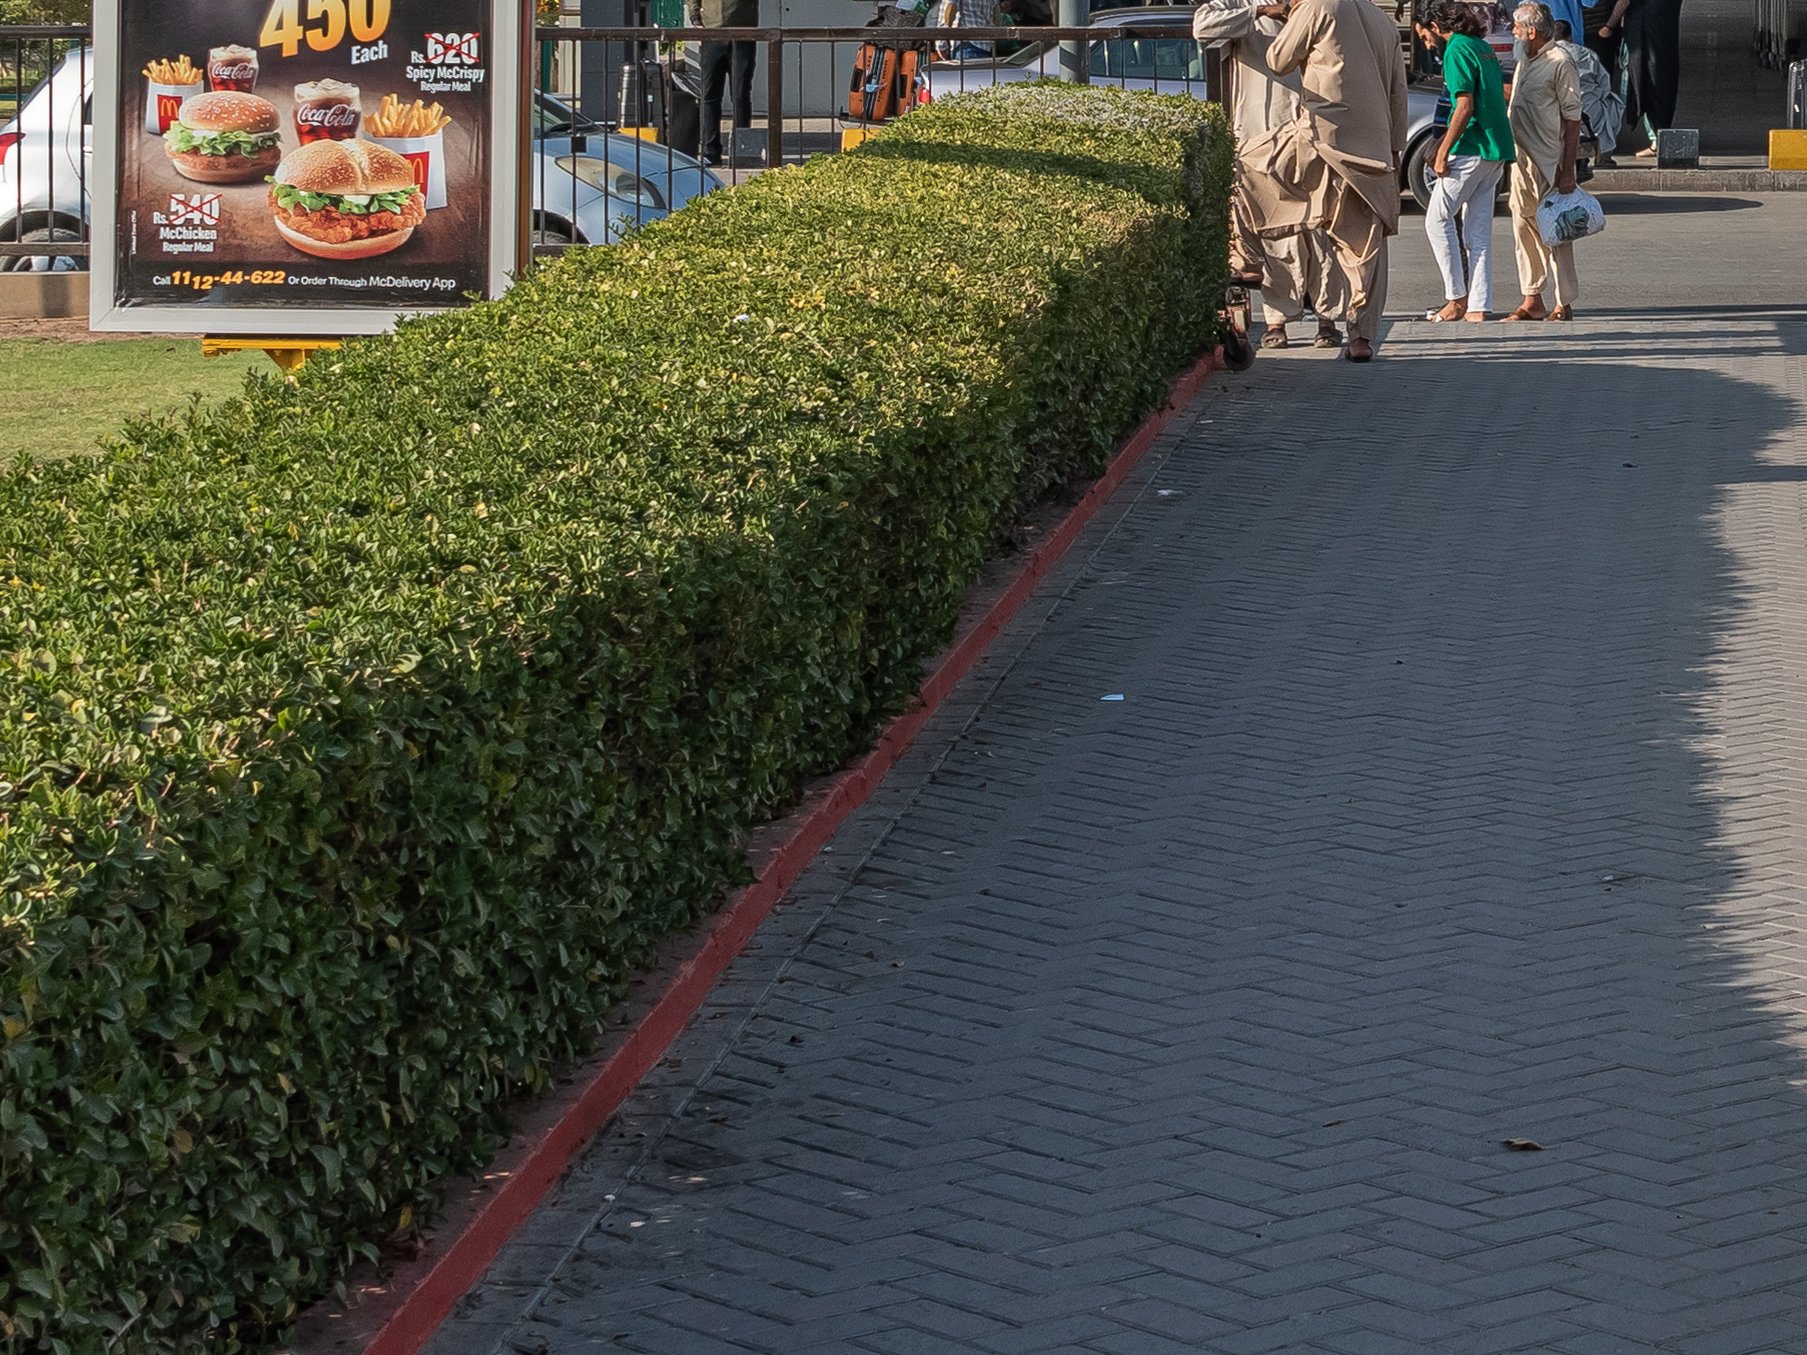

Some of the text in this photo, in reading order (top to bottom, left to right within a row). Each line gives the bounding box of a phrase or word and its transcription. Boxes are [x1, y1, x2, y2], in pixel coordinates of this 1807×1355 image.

[351, 40, 389, 65] Each
[426, 32, 479, 65] 620
[405, 65, 485, 83] Spicy McCrispy
[420, 80, 472, 94] Regular Meal
[169, 193, 221, 226] 540
[159, 226, 218, 240] McChicken
[162, 241, 214, 255] Regular Meal
[153, 275, 171, 286] Call
[288, 275, 300, 286] Or
[300, 275, 327, 286] Order
[328, 275, 368, 288] Through
[369, 275, 431, 290] McDelivery
[432, 276, 456, 289] App
